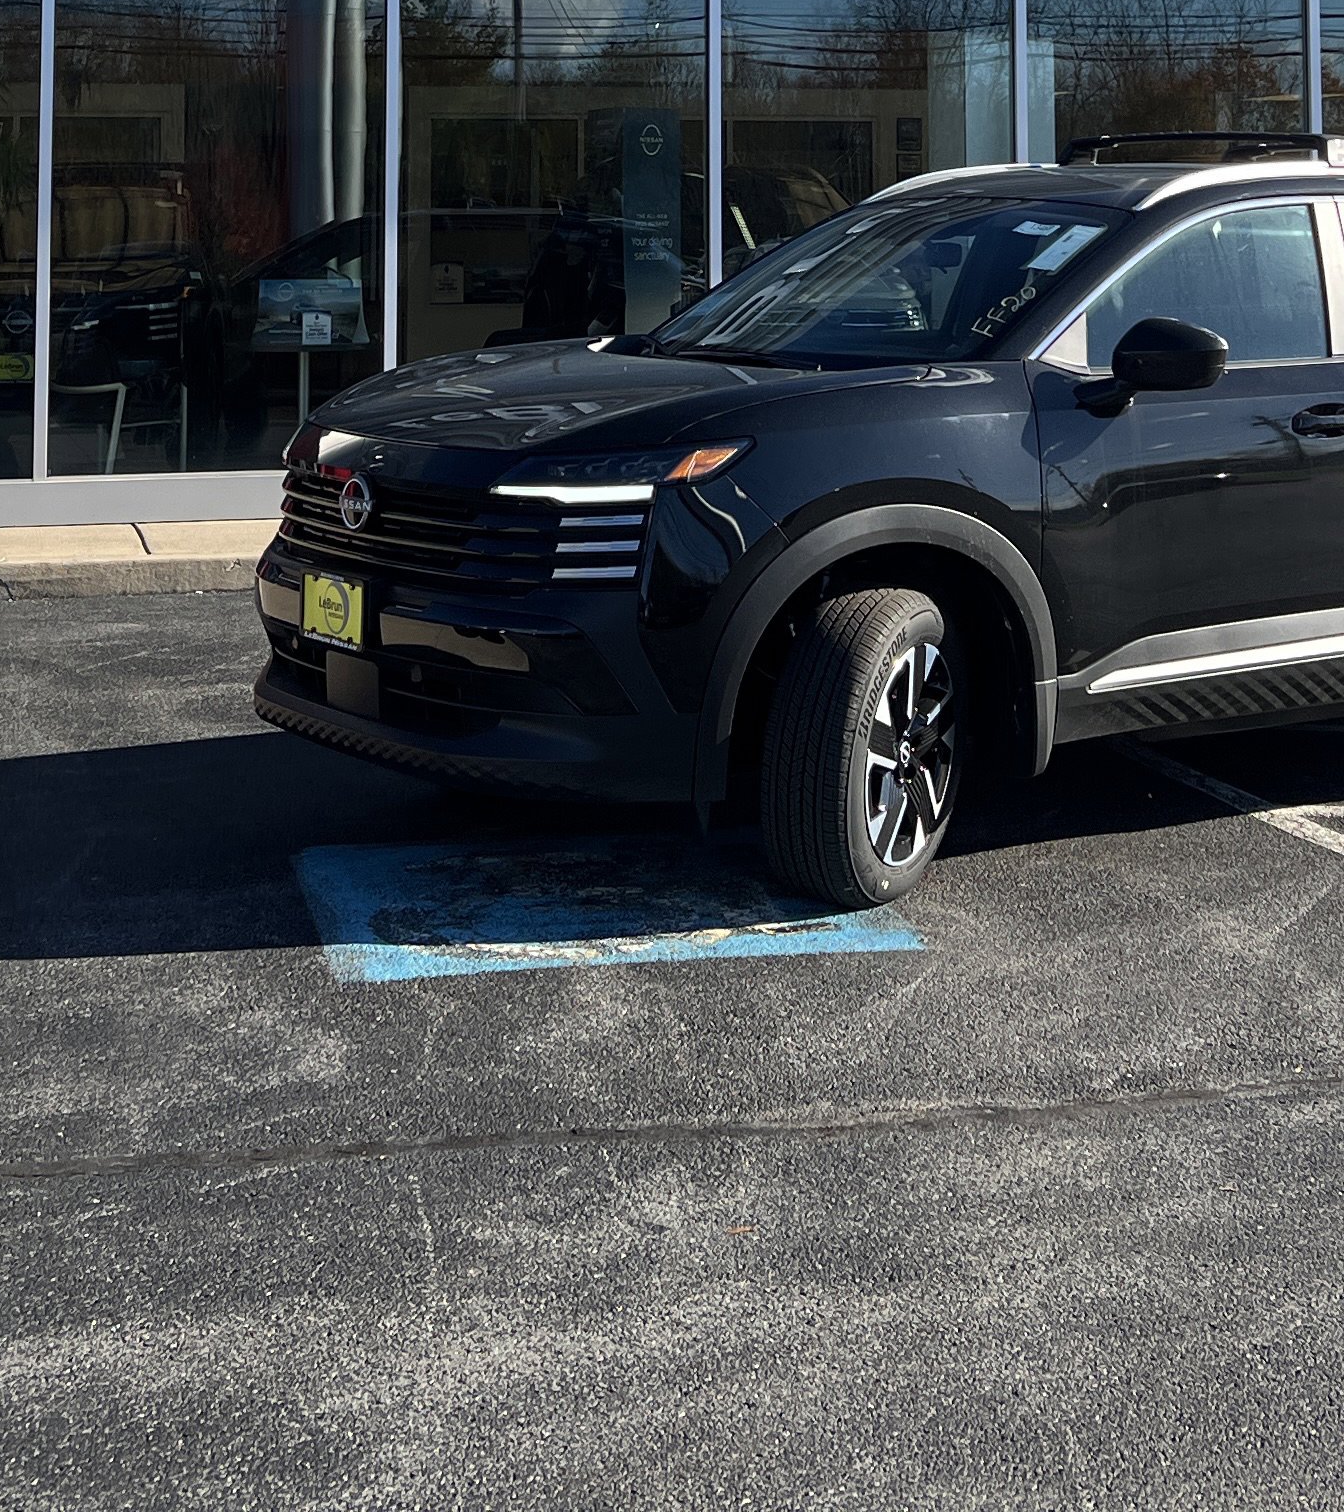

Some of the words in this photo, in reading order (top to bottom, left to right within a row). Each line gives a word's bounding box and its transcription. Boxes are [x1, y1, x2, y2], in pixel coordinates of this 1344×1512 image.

[631, 238, 647, 247] Your
[633, 251, 670, 262] sanctuary
[971, 286, 1036, 338] FF20
[319, 596, 343, 612] LeBrun
[857, 626, 908, 740] BRIDGESTONE
